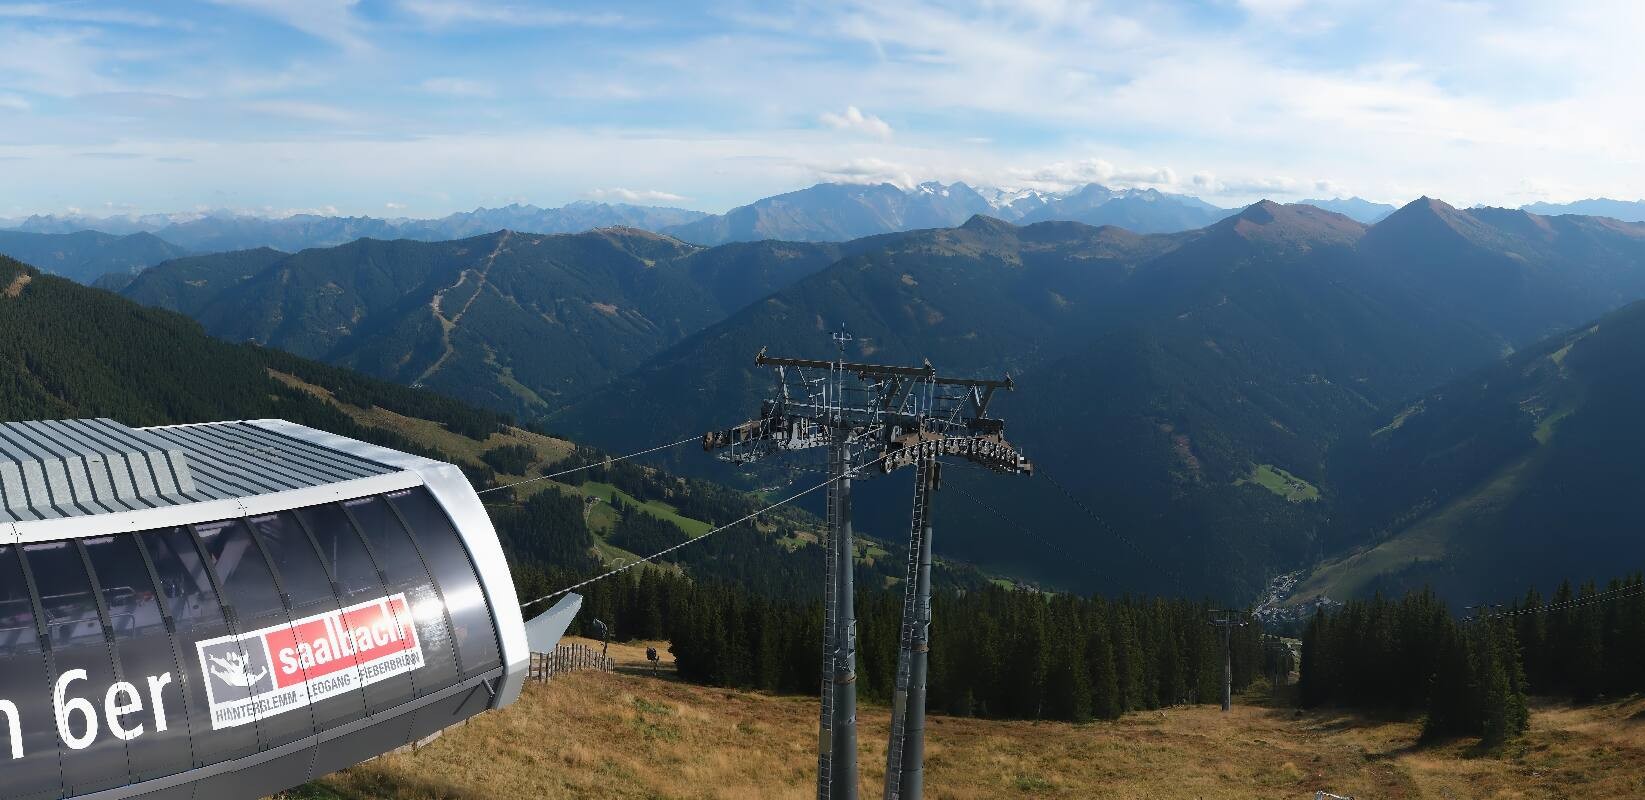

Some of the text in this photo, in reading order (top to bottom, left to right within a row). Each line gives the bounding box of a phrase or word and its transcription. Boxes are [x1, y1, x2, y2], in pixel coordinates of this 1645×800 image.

[278, 602, 409, 675] saalbach
[53, 668, 172, 750] 6er
[308, 674, 351, 698] LEOGANG
